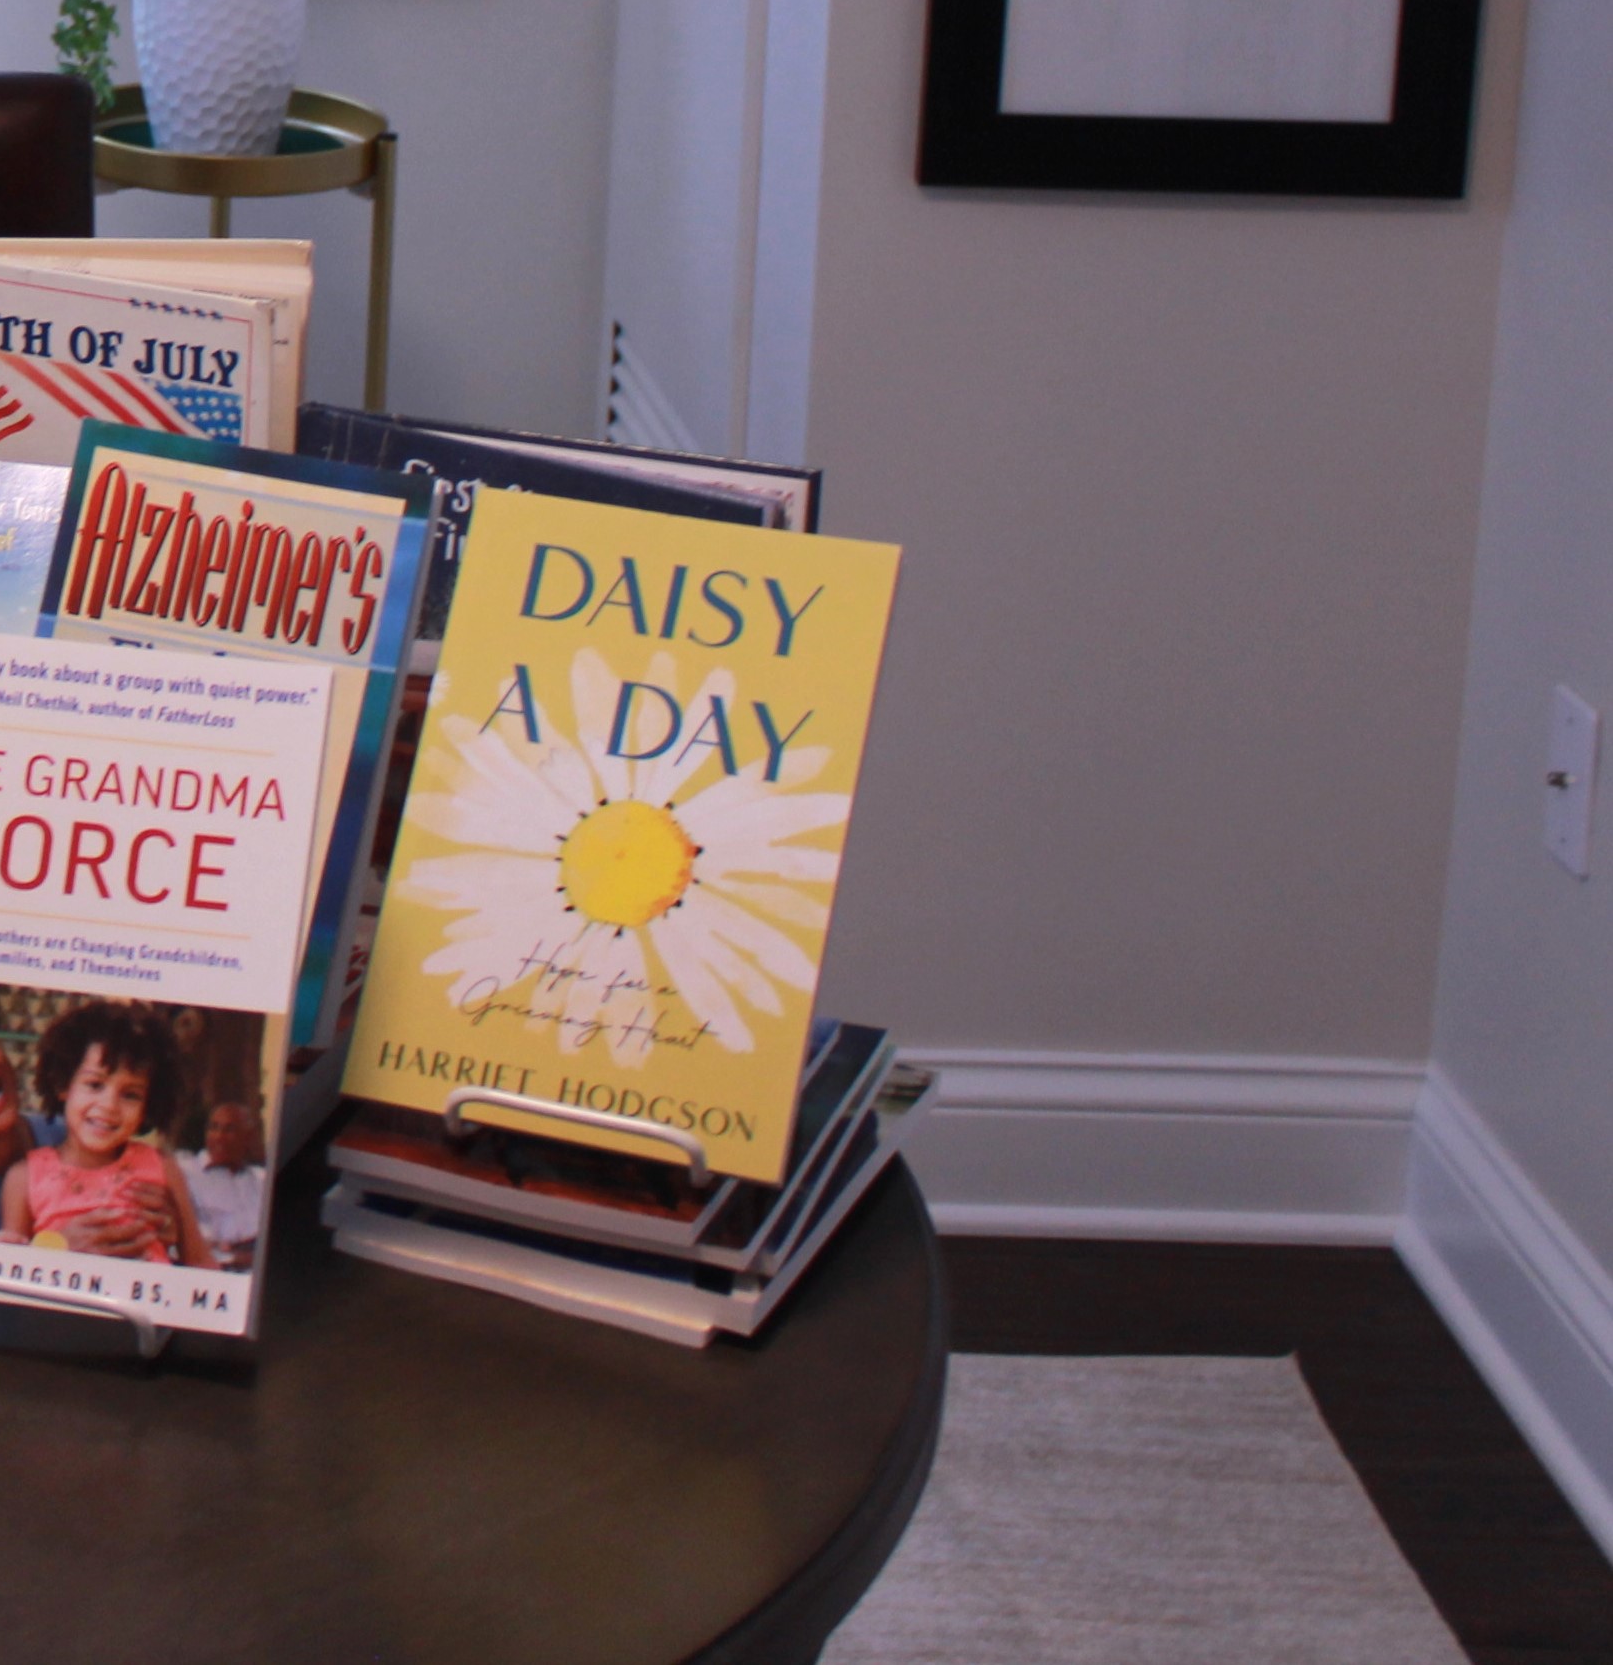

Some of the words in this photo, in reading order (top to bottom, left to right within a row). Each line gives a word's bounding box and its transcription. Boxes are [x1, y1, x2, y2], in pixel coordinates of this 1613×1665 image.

[69, 326, 123, 368] OF
[134, 338, 240, 387] JULY
[65, 461, 383, 655] Alzheimer's
[519, 543, 825, 658] DAISY
[9, 659, 50, 679] book
[53, 664, 99, 684] about
[104, 673, 112, 685] a
[116, 674, 164, 694] group
[169, 677, 205, 695] with
[209, 683, 251, 700] quiet
[26, 693, 83, 714] Chethik,
[87, 701, 135, 717] author
[138, 705, 152, 720] of
[157, 706, 236, 728] FatherLoss
[479, 664, 541, 744] A
[607, 681, 815, 783] DAY
[24, 755, 286, 822] GRANDMA
[44, 936, 67, 951] are
[70, 937, 136, 961] Changing
[139, 944, 243, 971] Grandchildren,
[50, 955, 75, 972] and
[79, 959, 162, 982] Themselves
[515, 939, 599, 993] Hope
[602, 970, 650, 1003] for
[656, 985, 679, 996] a
[459, 976, 612, 1048] Grieving
[616, 1006, 720, 1053] Heart
[377, 1041, 537, 1095] HARRIET
[557, 1077, 757, 1142] HODGSON
[131, 1281, 171, 1308] BS,
[191, 1290, 229, 1312] MA
